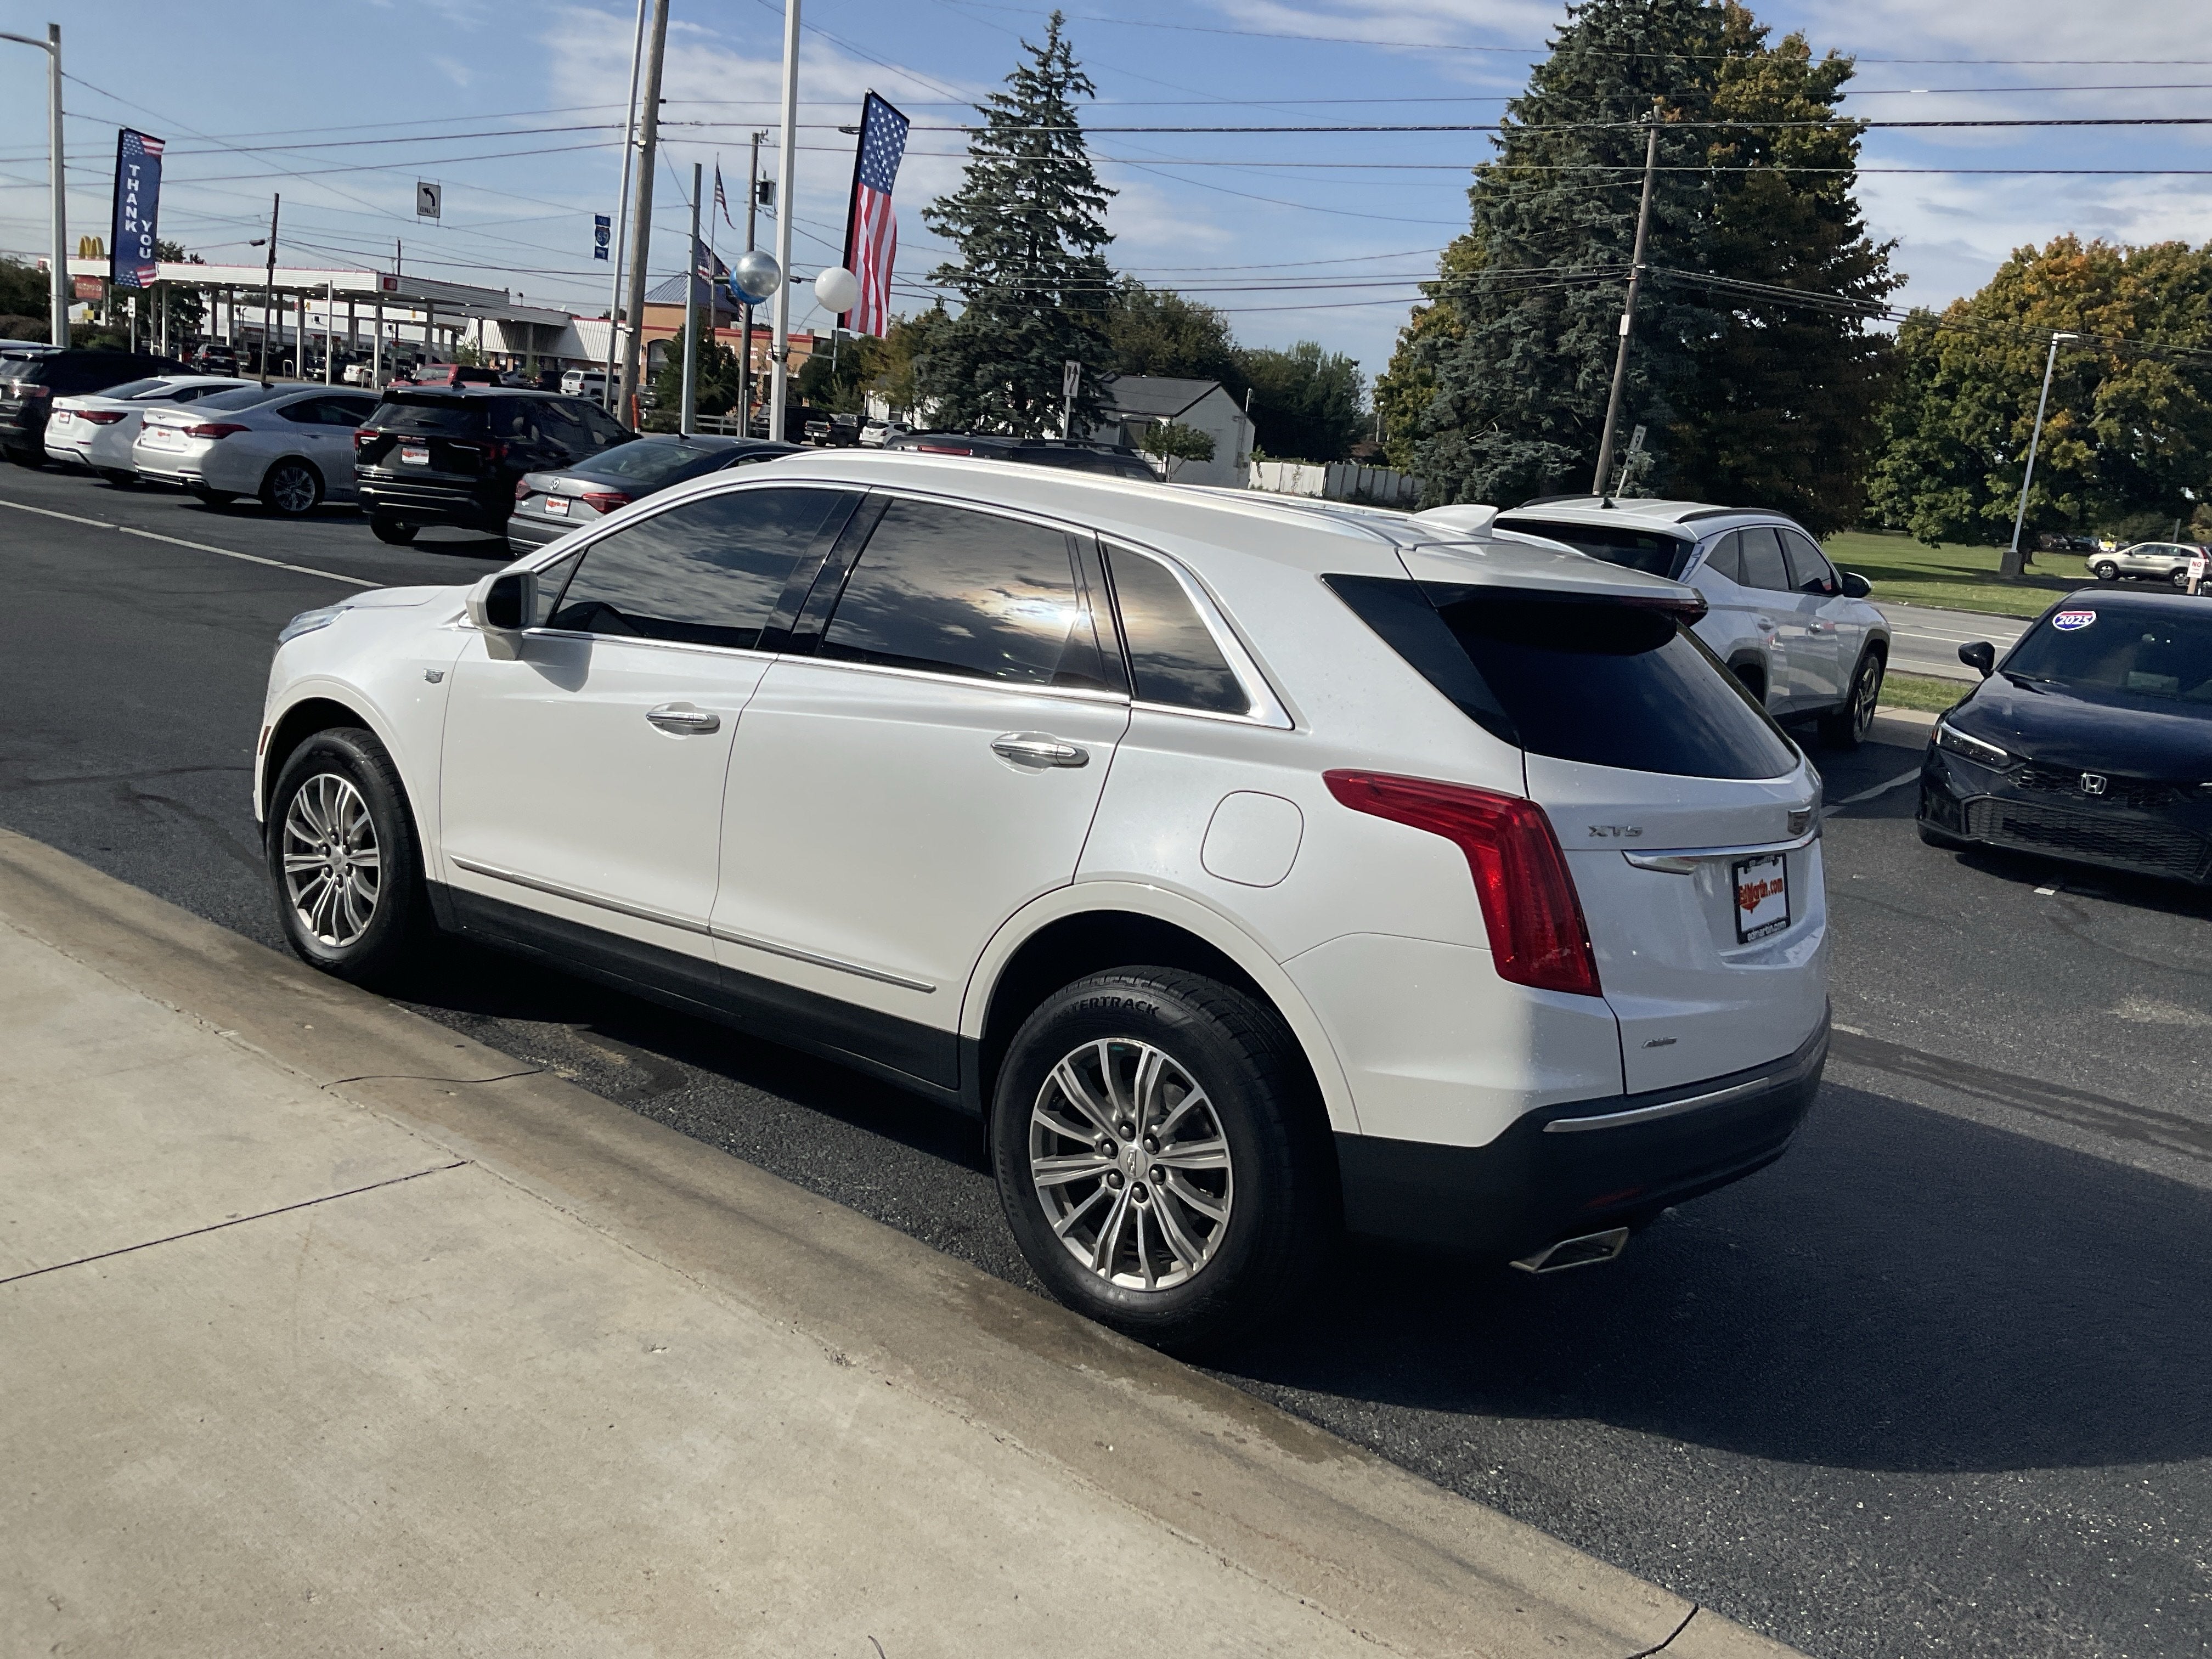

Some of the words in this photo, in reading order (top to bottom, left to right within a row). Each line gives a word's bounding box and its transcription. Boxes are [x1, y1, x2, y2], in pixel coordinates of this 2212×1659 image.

[125, 163, 140, 233] THANK
[139, 219, 153, 259] YOU
[420, 206, 436, 215] ONLY
[2056, 616, 2092, 625] 2025
[1588, 826, 1643, 837] XT5
